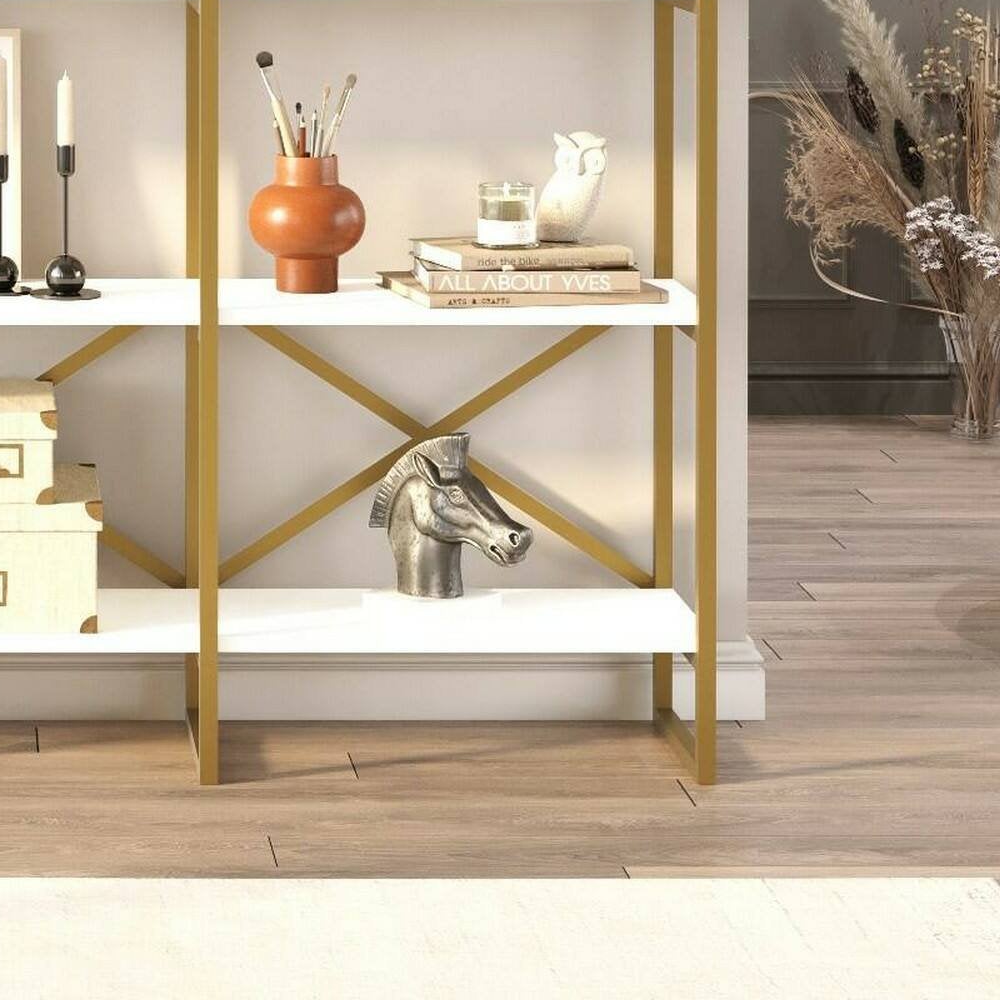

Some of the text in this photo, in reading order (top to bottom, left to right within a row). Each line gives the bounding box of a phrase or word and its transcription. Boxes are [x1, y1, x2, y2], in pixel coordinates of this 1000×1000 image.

[438, 274, 611, 291] ALL ABOUT YVES
